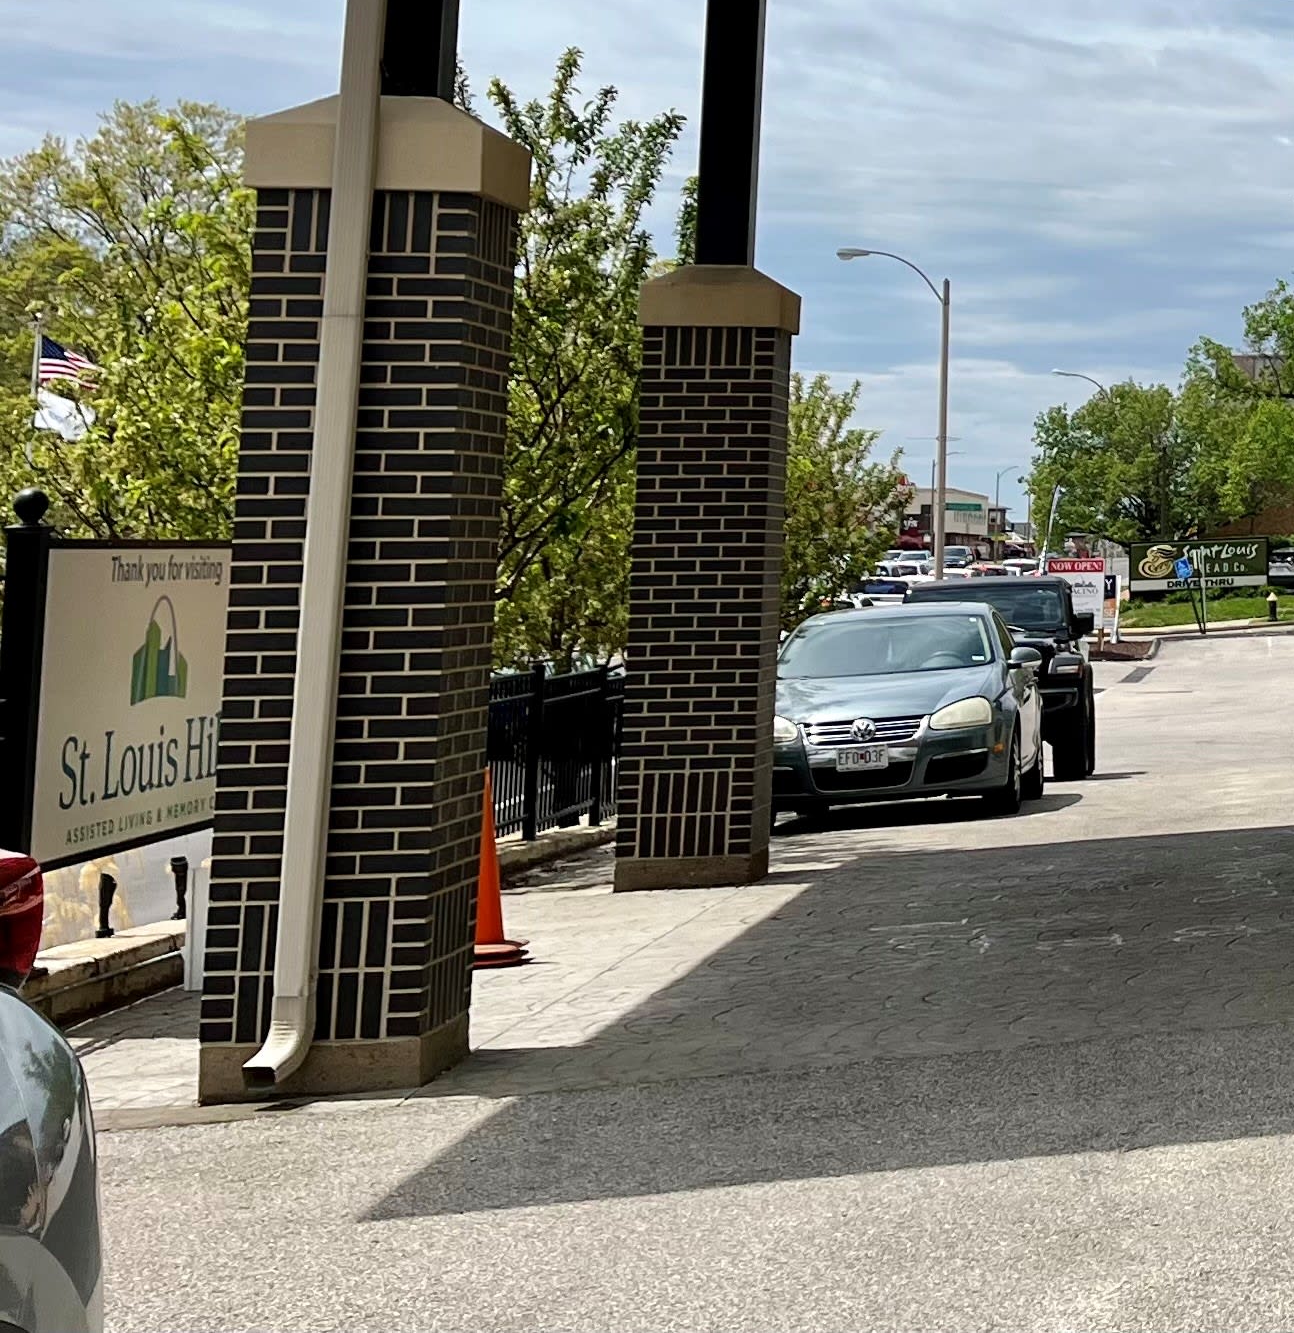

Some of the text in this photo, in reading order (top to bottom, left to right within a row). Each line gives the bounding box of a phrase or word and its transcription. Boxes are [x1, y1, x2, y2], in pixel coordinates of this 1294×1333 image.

[1220, 543, 1259, 559] Louis
[112, 554, 223, 588] Thank you for visiting
[1050, 561, 1102, 571] NOW OPEN!
[1204, 578, 1235, 587] THRU
[59, 735, 95, 810] St.
[101, 724, 178, 800] Louis
[65, 819, 114, 845] ASSISTED
[118, 810, 152, 832] LIVING
[167, 797, 206, 818] MEMORY
